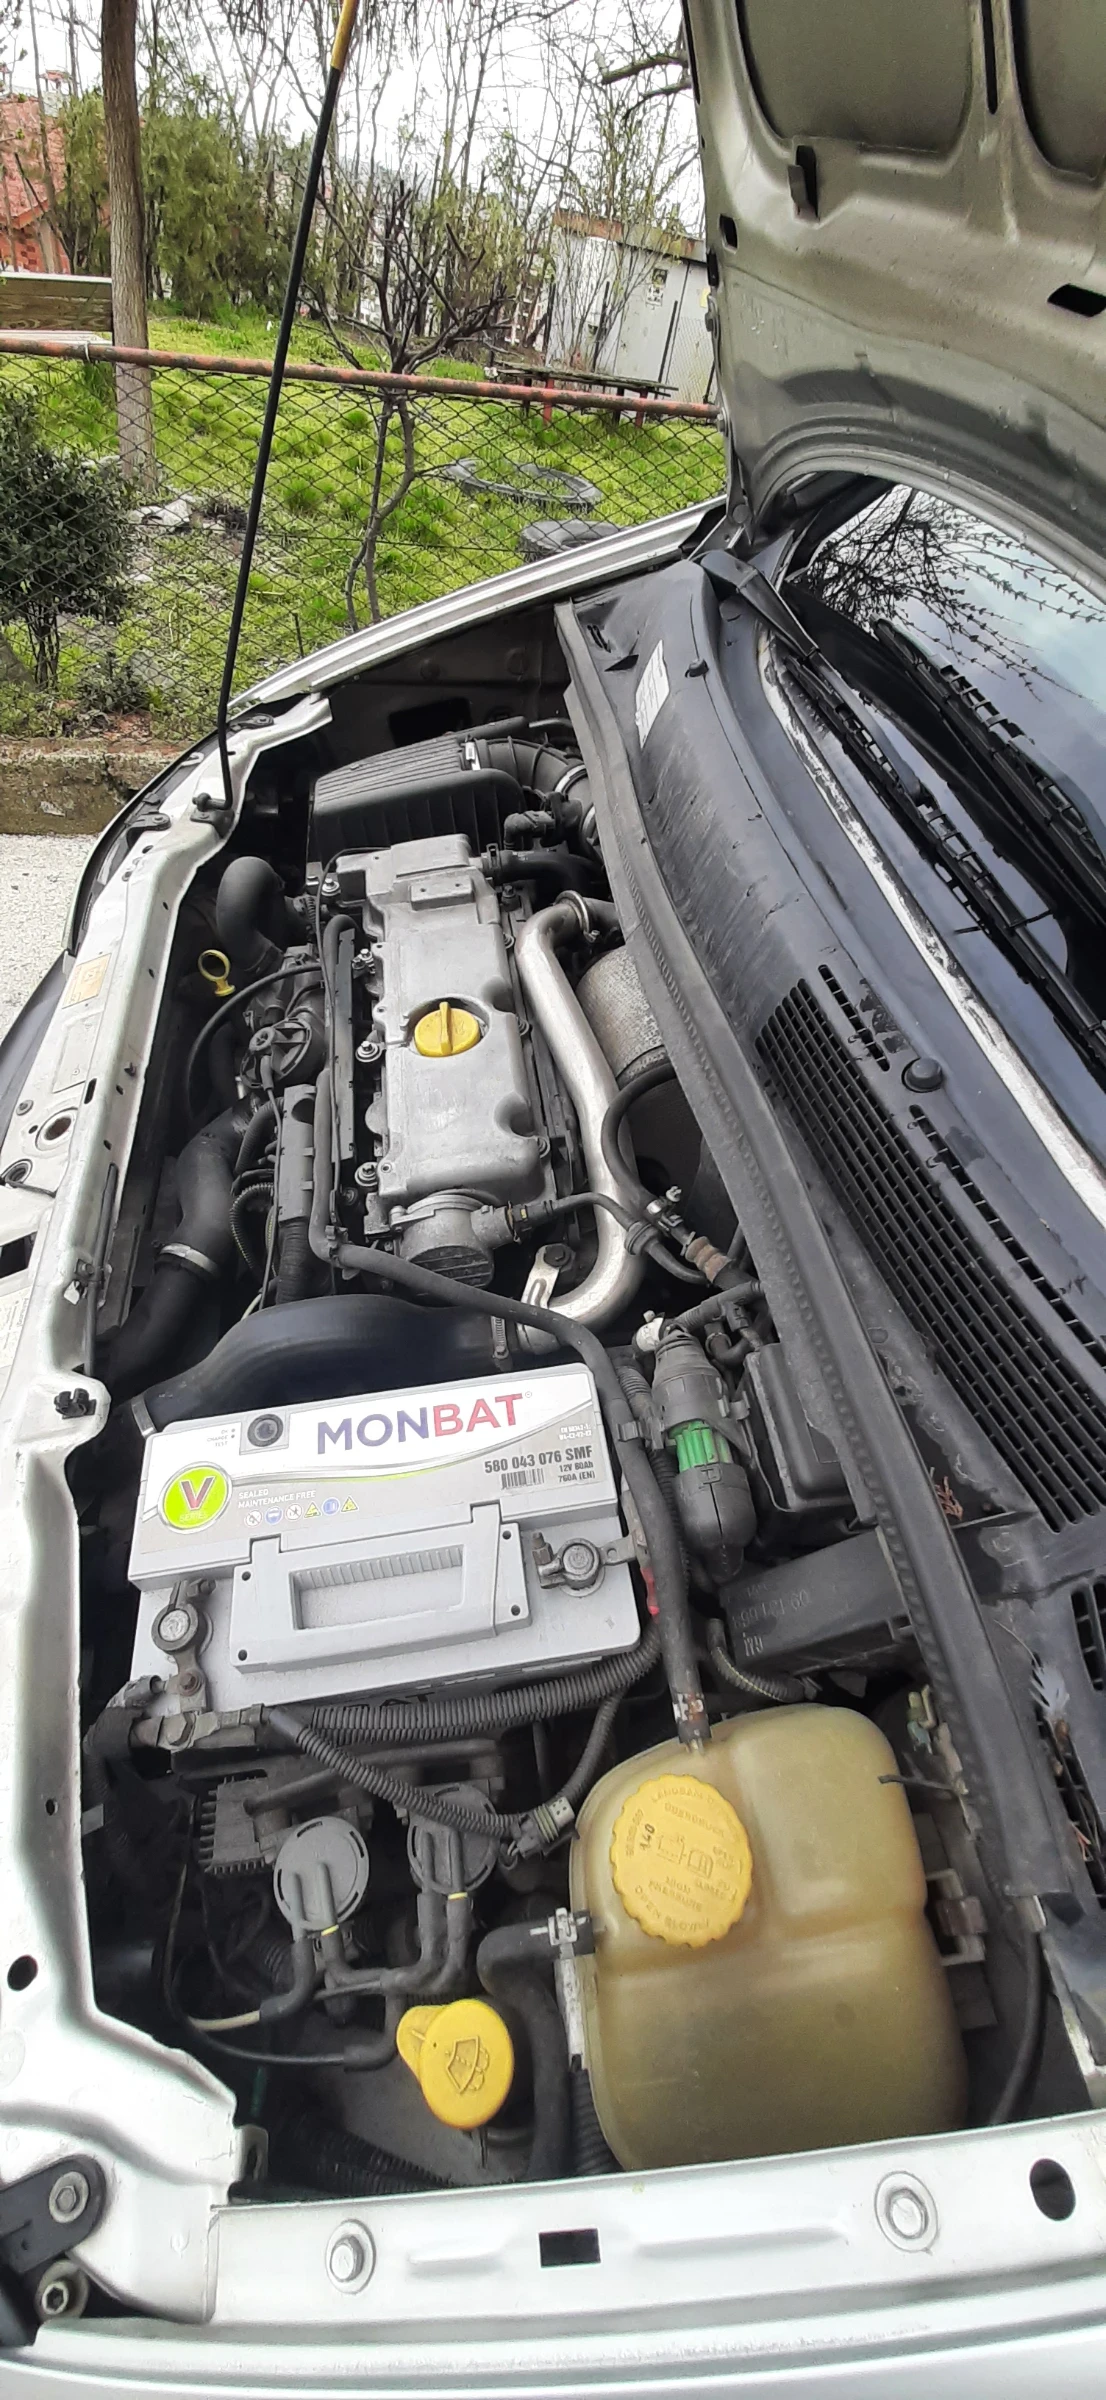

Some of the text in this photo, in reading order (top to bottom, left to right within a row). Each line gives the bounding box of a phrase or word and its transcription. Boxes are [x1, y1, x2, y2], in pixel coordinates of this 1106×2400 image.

[317, 1393, 523, 1455] MONBAT
[484, 1445, 592, 1473] 580 043 076 SMF
[559, 1461, 594, 1473] 12V 80Ah
[558, 1471, 596, 1482] 760A (EN)
[180, 1476, 216, 1511] V
[238, 1489, 269, 1499] SEALED
[238, 1490, 316, 1509] MAINTENANCE FREE
